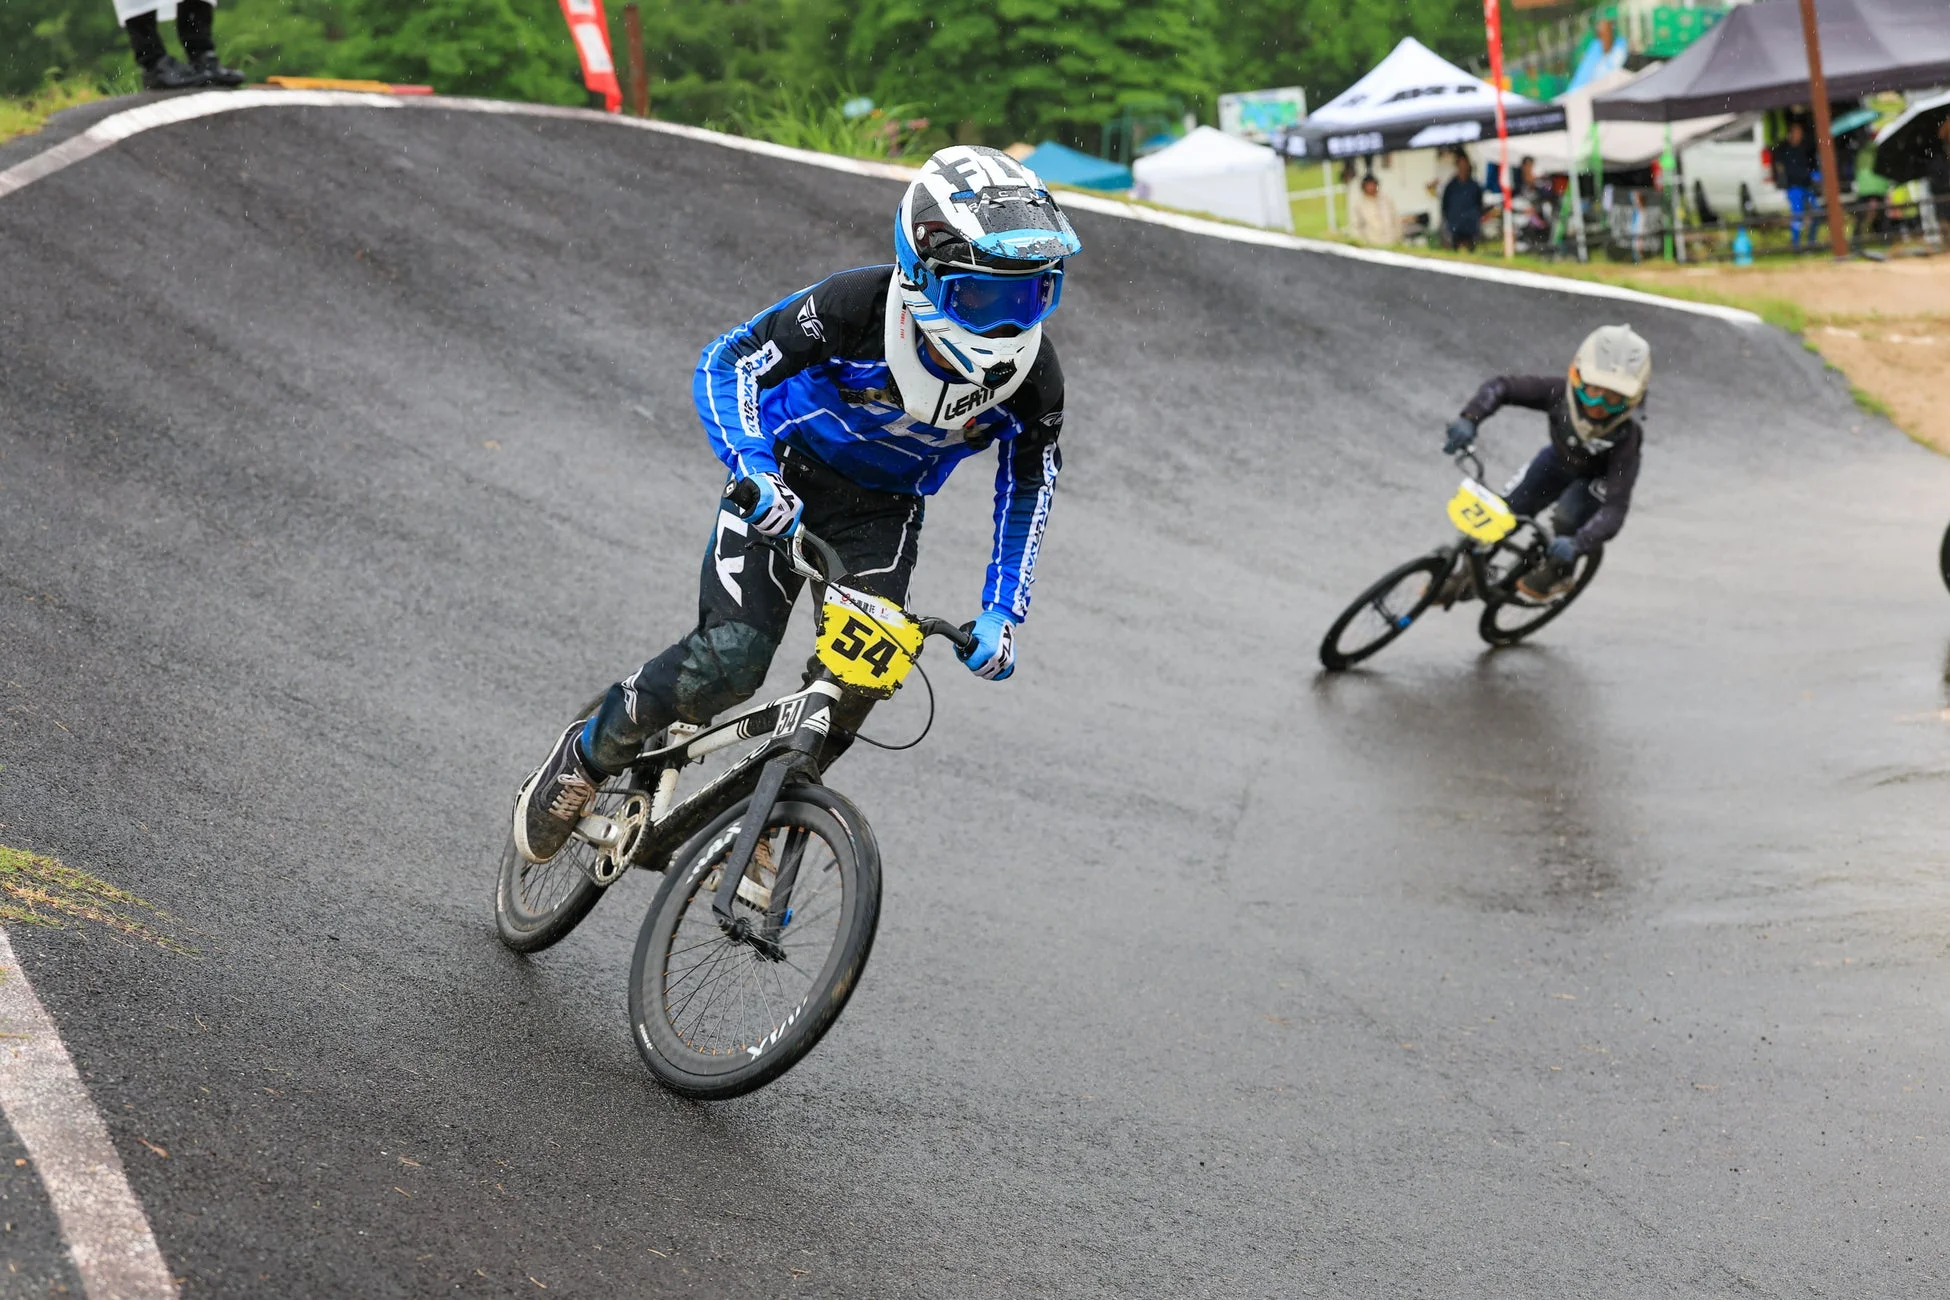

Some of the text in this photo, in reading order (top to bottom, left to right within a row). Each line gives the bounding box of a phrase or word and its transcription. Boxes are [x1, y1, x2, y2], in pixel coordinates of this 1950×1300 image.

[1462, 503, 1492, 529] 21
[714, 503, 749, 608] LY
[831, 616, 898, 678] 54
[776, 701, 801, 734] 54
